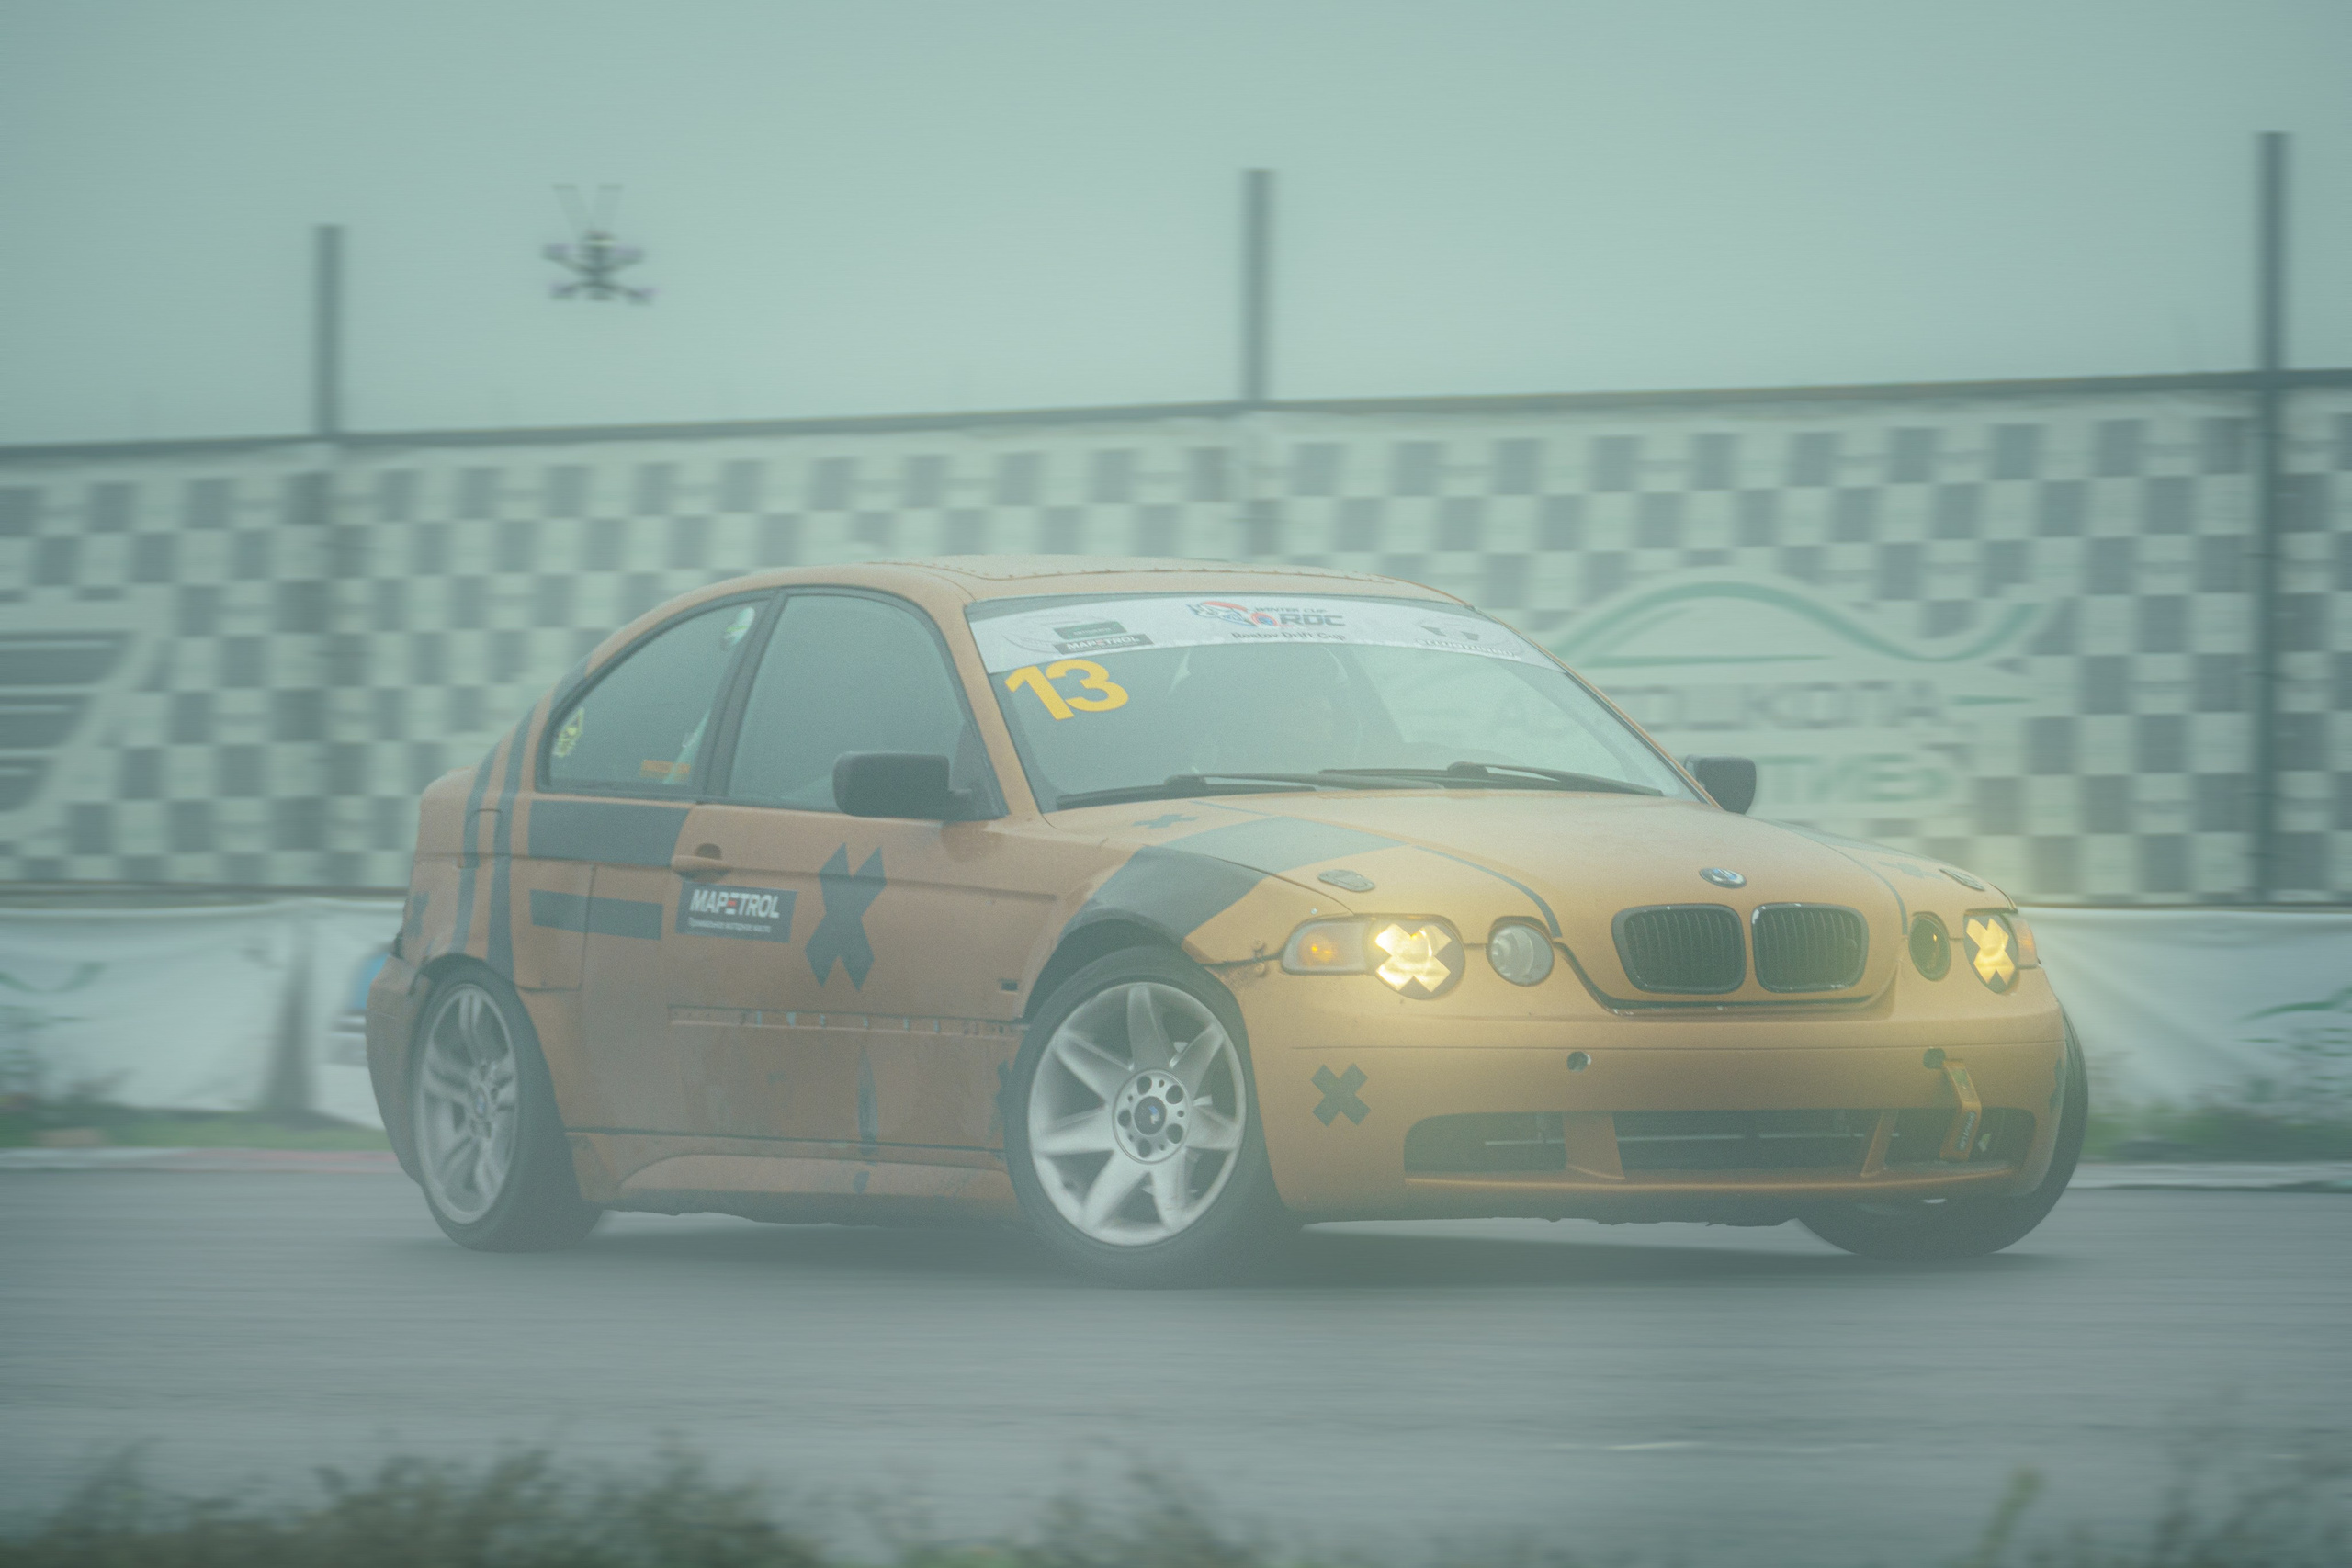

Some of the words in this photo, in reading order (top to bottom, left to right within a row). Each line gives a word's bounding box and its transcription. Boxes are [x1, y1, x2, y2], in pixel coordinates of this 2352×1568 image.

[1066, 636, 1139, 650] MAPETROL
[1317, 633, 1346, 641] Cup
[1004, 659, 1129, 721] 13
[689, 889, 780, 918] MAPETROL
